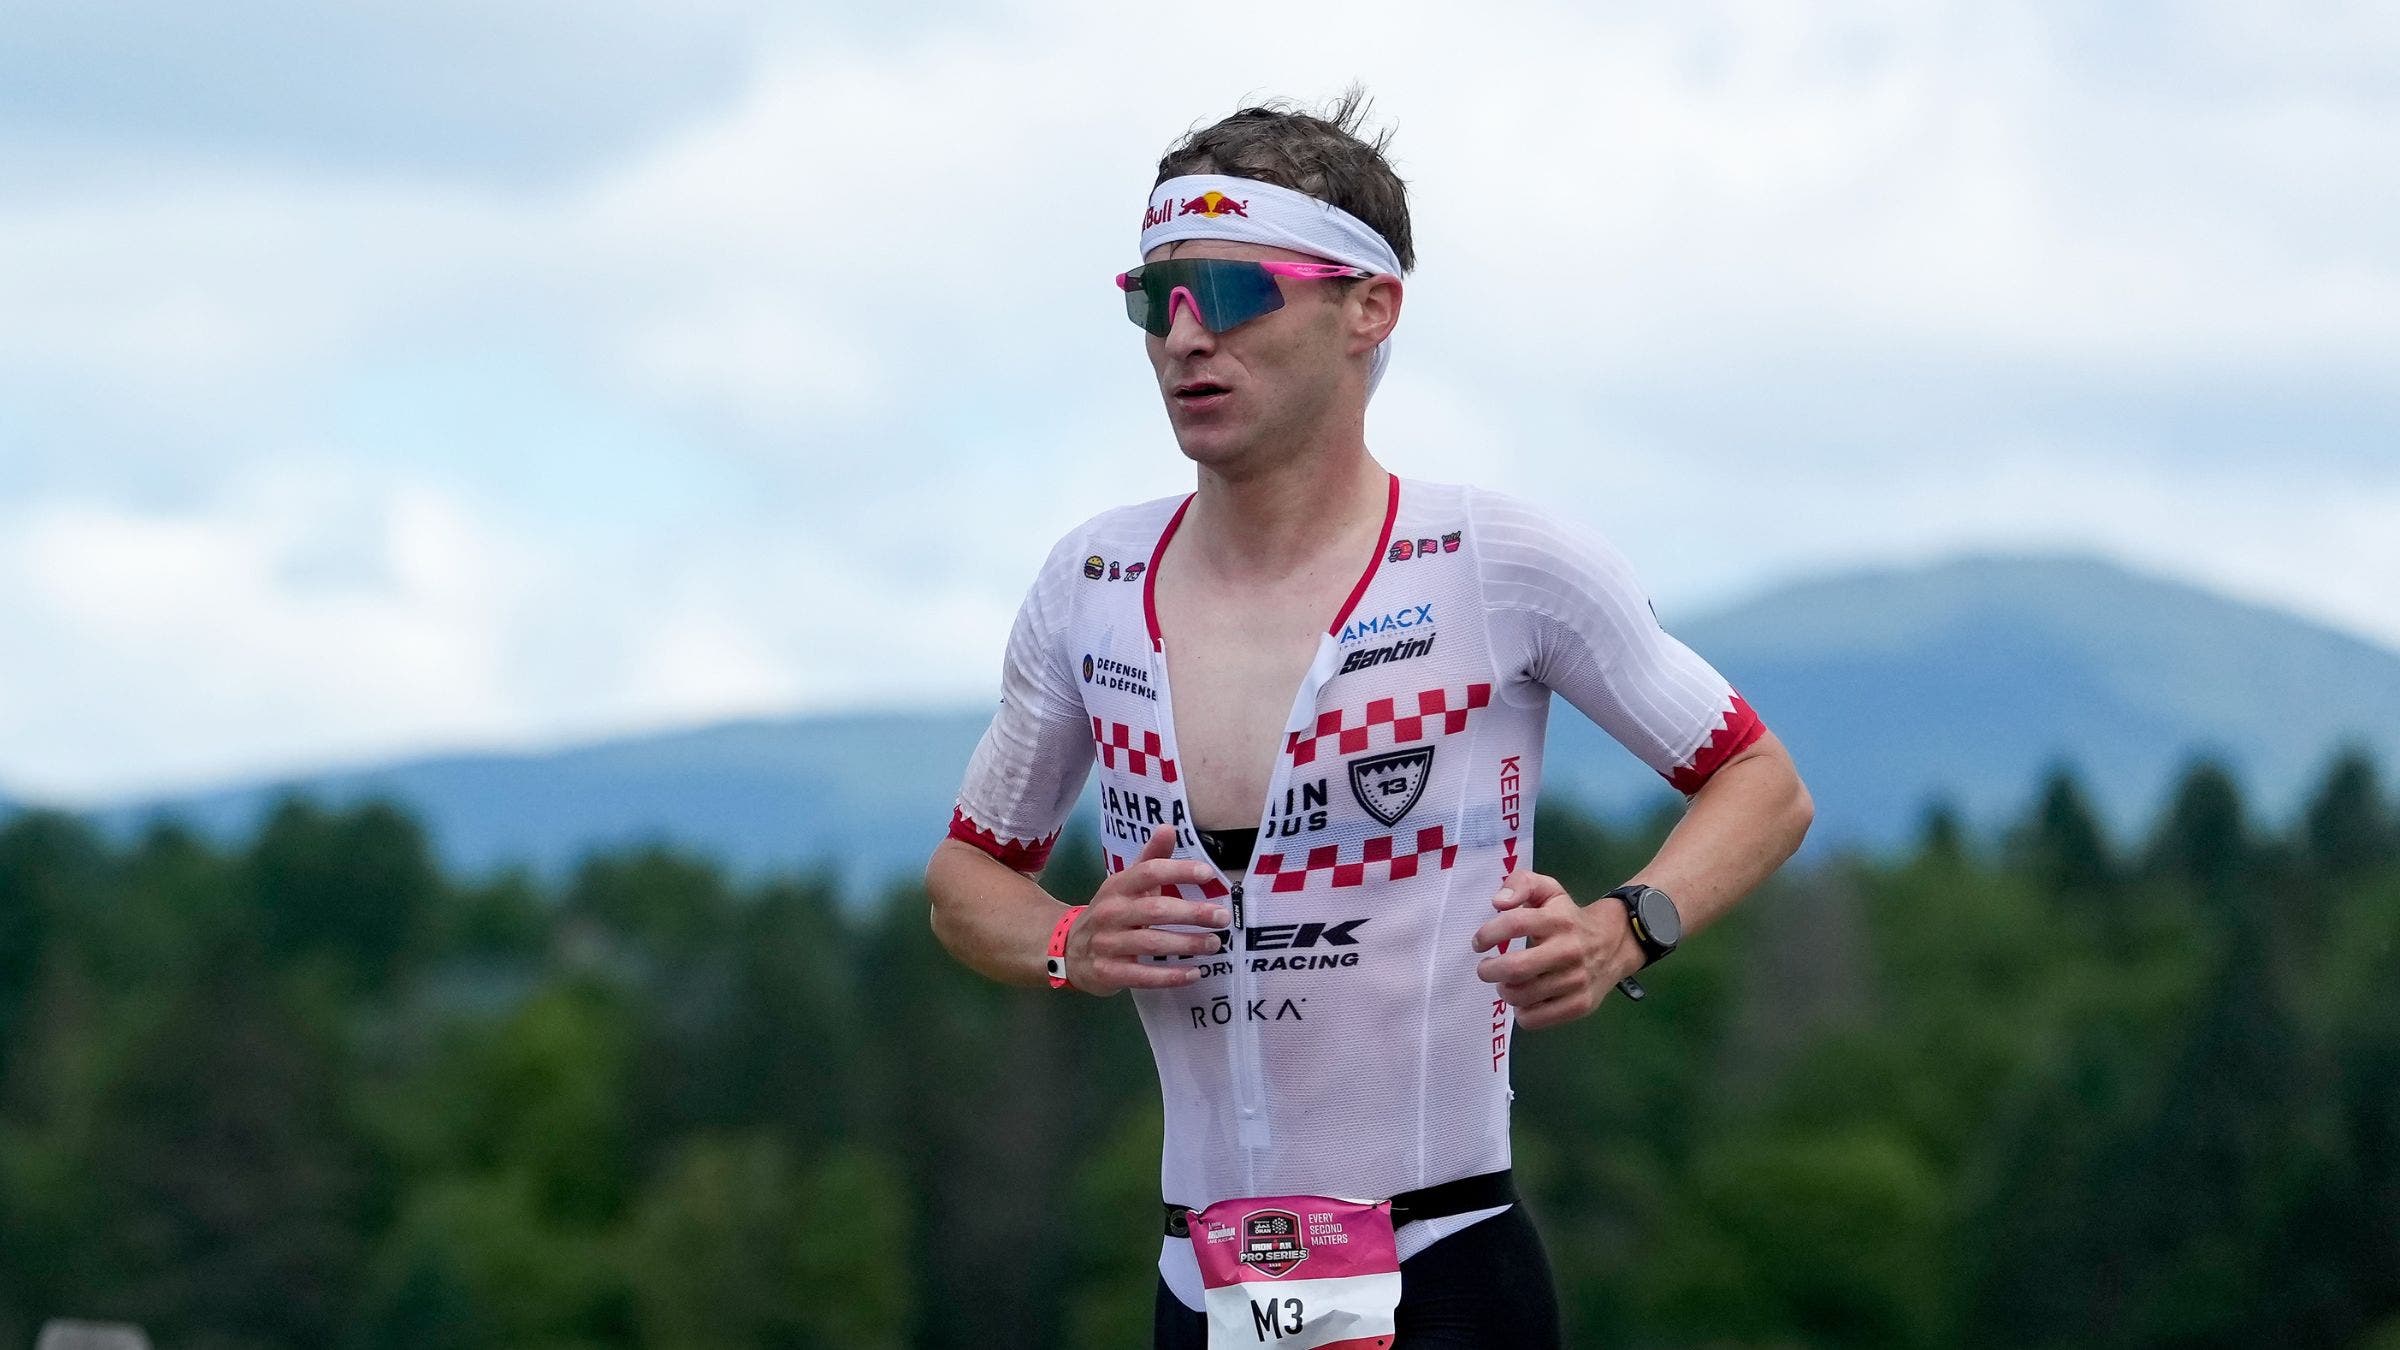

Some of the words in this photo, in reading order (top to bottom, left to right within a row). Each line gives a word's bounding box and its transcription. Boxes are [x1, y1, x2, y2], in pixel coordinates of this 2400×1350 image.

[1146, 199, 1173, 229] Bull
[1340, 603, 1433, 644] AMACX
[1339, 632, 1437, 676] Santini
[1097, 657, 1148, 682] DEFENSIE
[1096, 674, 1107, 687] LA
[1109, 677, 1157, 701] DÉFENSE
[1377, 777, 1408, 796] 13
[1500, 755, 1520, 832] KEEP
[1251, 952, 1360, 973] RACING
[1492, 998, 1507, 1073] RIEL
[1308, 1212, 1334, 1224] EVERY
[1310, 1223, 1343, 1235] SECOND
[1311, 1234, 1348, 1246] MATTERS
[1240, 1252, 1264, 1263] PRO
[1266, 1249, 1307, 1261] SERIES
[1250, 1298, 1304, 1342] M3
